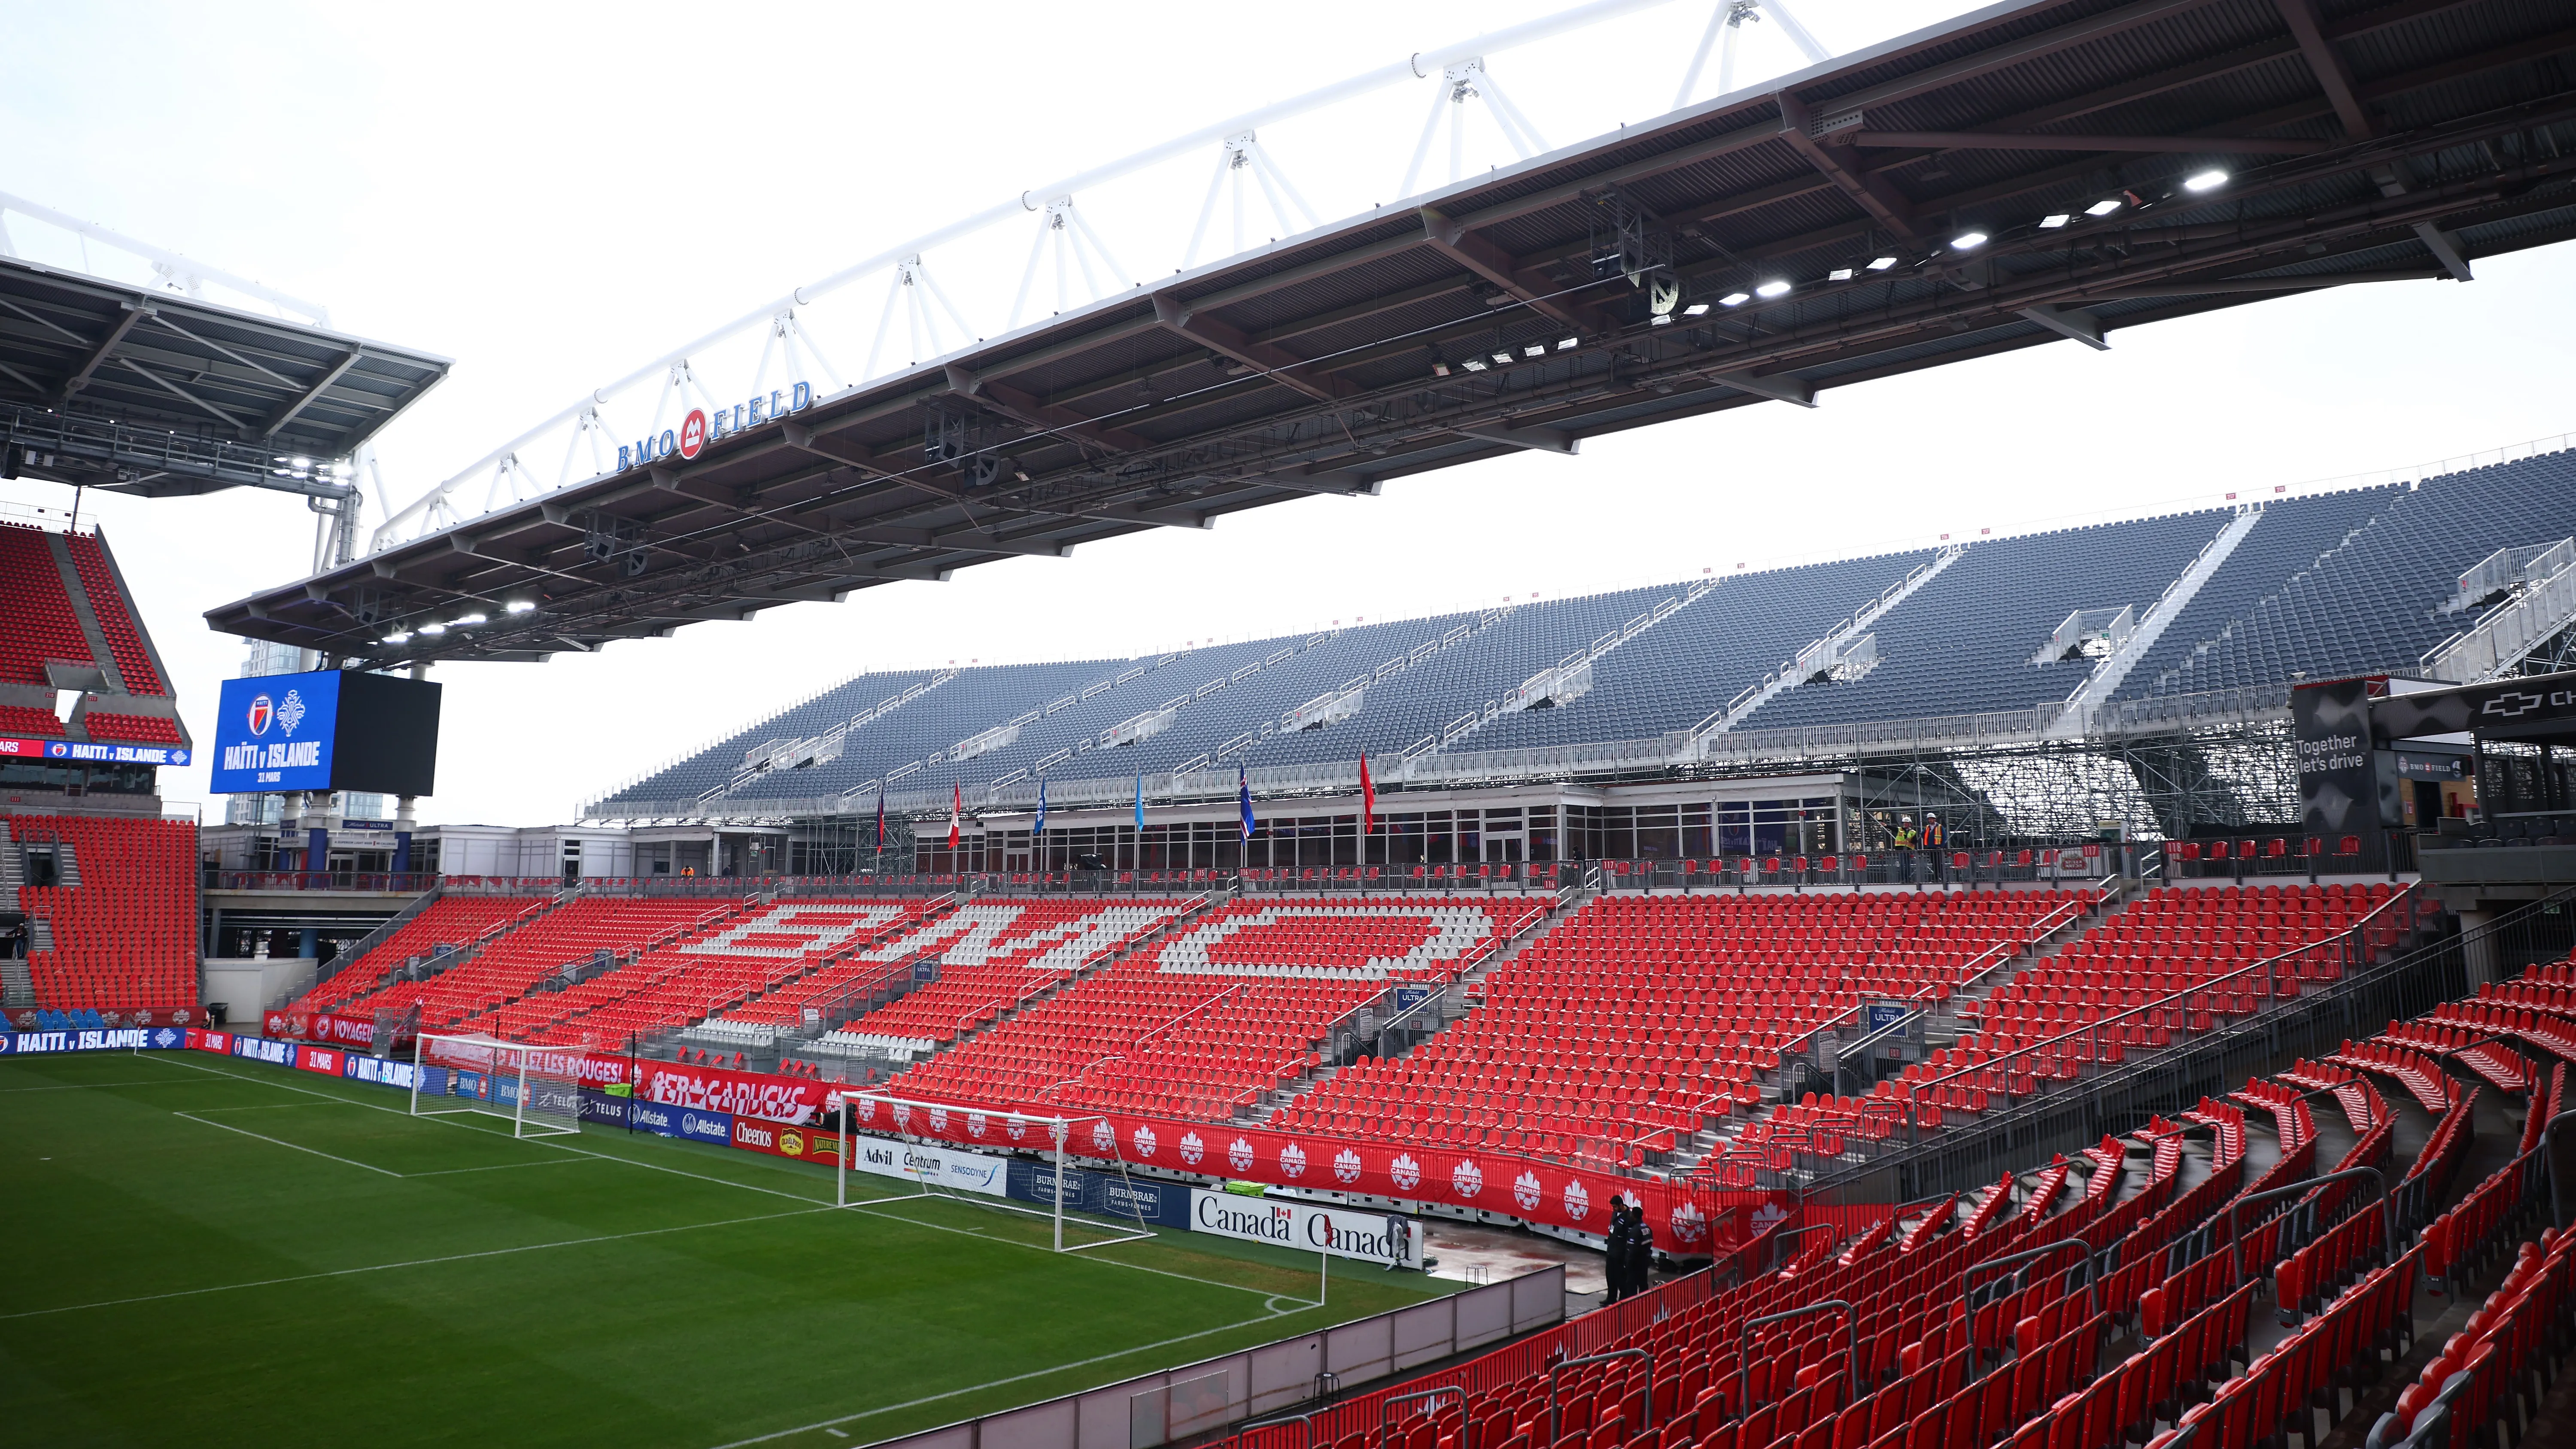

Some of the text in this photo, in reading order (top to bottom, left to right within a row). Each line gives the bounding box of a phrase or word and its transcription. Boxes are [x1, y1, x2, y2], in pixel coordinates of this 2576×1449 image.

[616, 380, 813, 473] BMO FIELD
[73, 744, 108, 759] HAITI
[115, 747, 167, 763] ISLANDE
[2297, 735, 2357, 756] Together
[224, 741, 258, 770] HAÏTI
[267, 741, 320, 768] ISLANDE
[2299, 753, 2363, 773] let's drive
[258, 772, 281, 783] 31 MARS
[2084, 846, 2096, 856] 117
[2168, 842, 2181, 852] 118
[1875, 1014, 1900, 1022] ULTRA
[335, 1020, 374, 1042] VOYAGEU
[17, 1030, 149, 1052] HAITI v ISLANDE
[205, 1033, 224, 1050] 31 MARS
[242, 1038, 259, 1057] HAITI
[260, 1040, 286, 1063] ISLANDE
[309, 1051, 332, 1070] 31 MARS
[544, 1052, 565, 1074] LES
[567, 1055, 623, 1084] ROUGES!
[357, 1057, 379, 1081] HAITI
[381, 1060, 413, 1088] ISLANDE
[460, 1077, 476, 1091] BMO
[501, 1085, 519, 1099] BMO
[596, 1103, 622, 1117] TELUS
[639, 1110, 668, 1127] Allstate
[695, 1119, 726, 1137] Allstate
[736, 1122, 772, 1148] Cheerios
[1048, 1126, 1068, 1134] CANDA
[814, 1139, 832, 1151] NATURE
[1133, 1138, 1156, 1146] CANADA
[864, 1147, 892, 1166] Advil
[904, 1152, 940, 1170] Centrum
[1229, 1151, 1253, 1159] CANADA
[1280, 1157, 1306, 1165] CANADA
[951, 1164, 987, 1178] SENSODYNE
[1391, 1166, 1420, 1177] CANADA
[1036, 1174, 1078, 1190] BURNRAE
[1452, 1175, 1483, 1185] CANADA
[1109, 1187, 1154, 1203] BURNBRAE
[1514, 1184, 1540, 1197] CANADA
[1111, 1199, 1128, 1207] FARMS
[1564, 1196, 1589, 1206] CANADA
[1198, 1196, 1292, 1241] Canada
